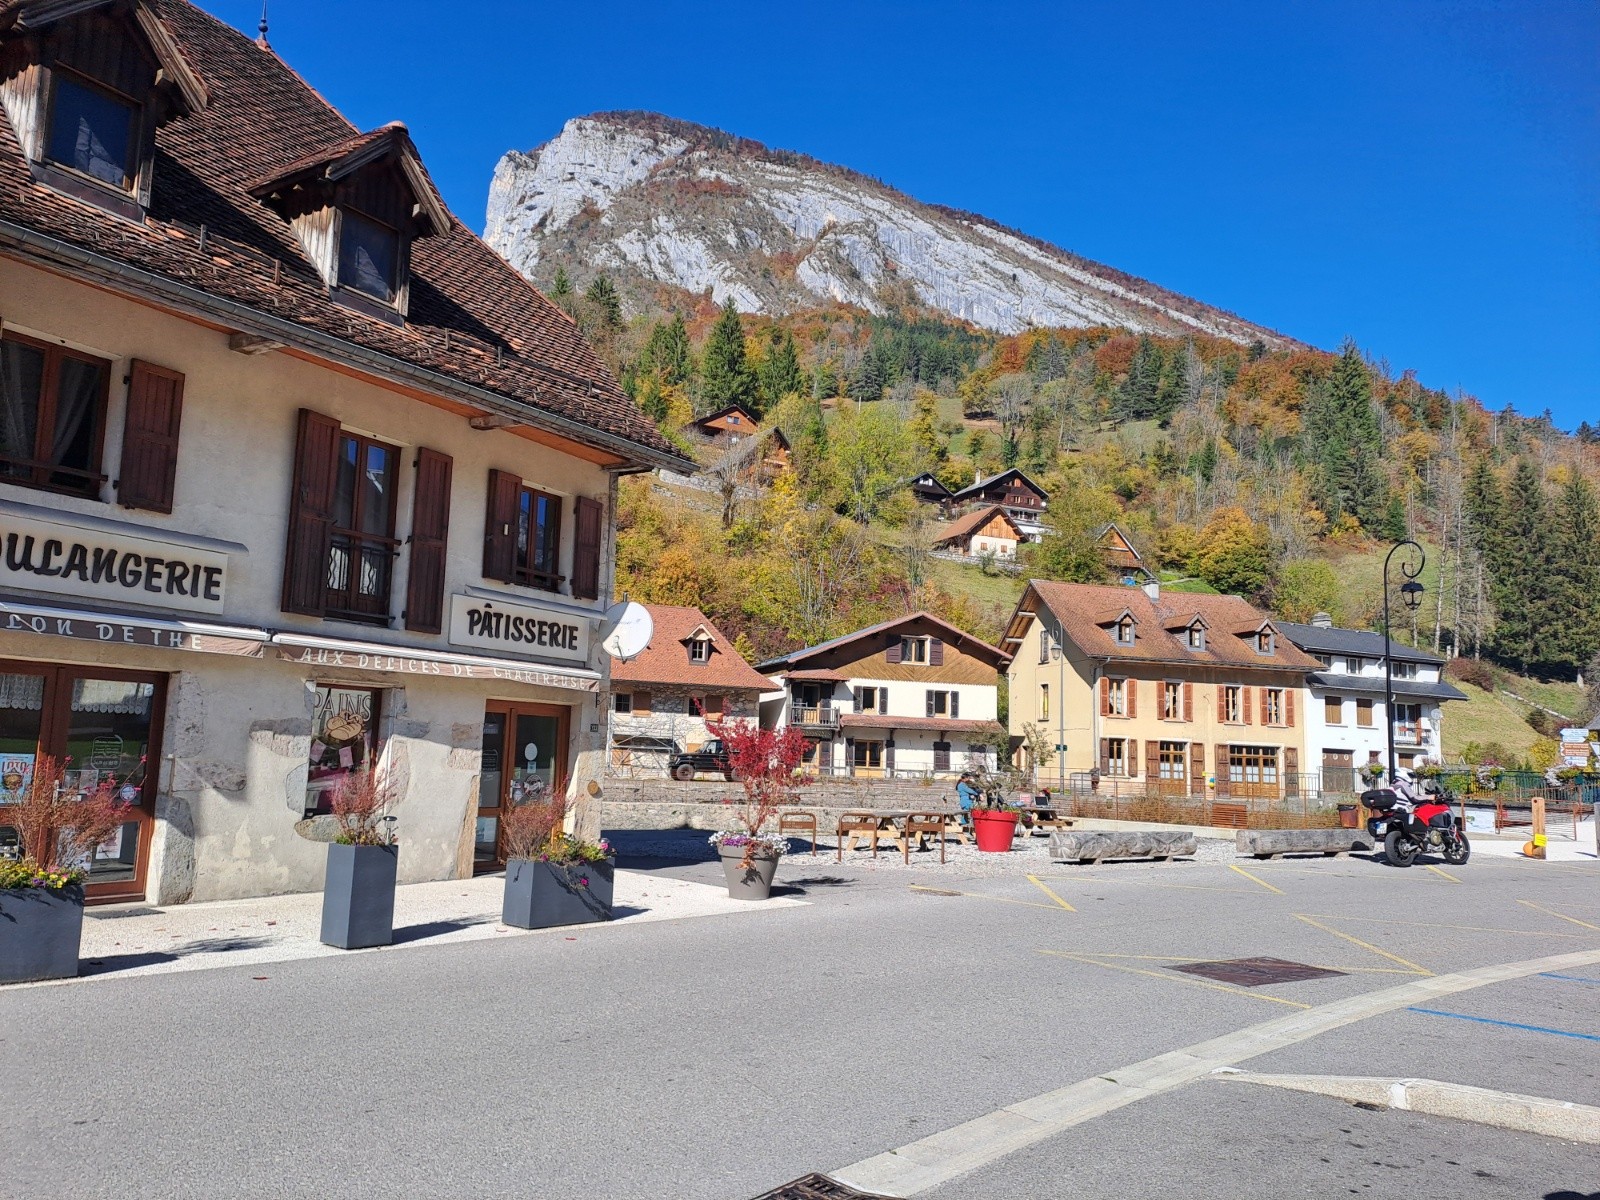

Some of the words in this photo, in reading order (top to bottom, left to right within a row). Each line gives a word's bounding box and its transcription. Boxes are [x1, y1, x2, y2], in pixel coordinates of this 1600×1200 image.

[0, 532, 223, 601] ULANGERIE
[95, 623, 135, 643] DE
[151, 629, 202, 650] THE
[466, 603, 579, 651] PÂTISSERIE
[300, 647, 345, 665] AUX
[358, 653, 441, 674] DELICES
[451, 663, 474, 677] DE
[493, 667, 586, 690] CHARTREUSE
